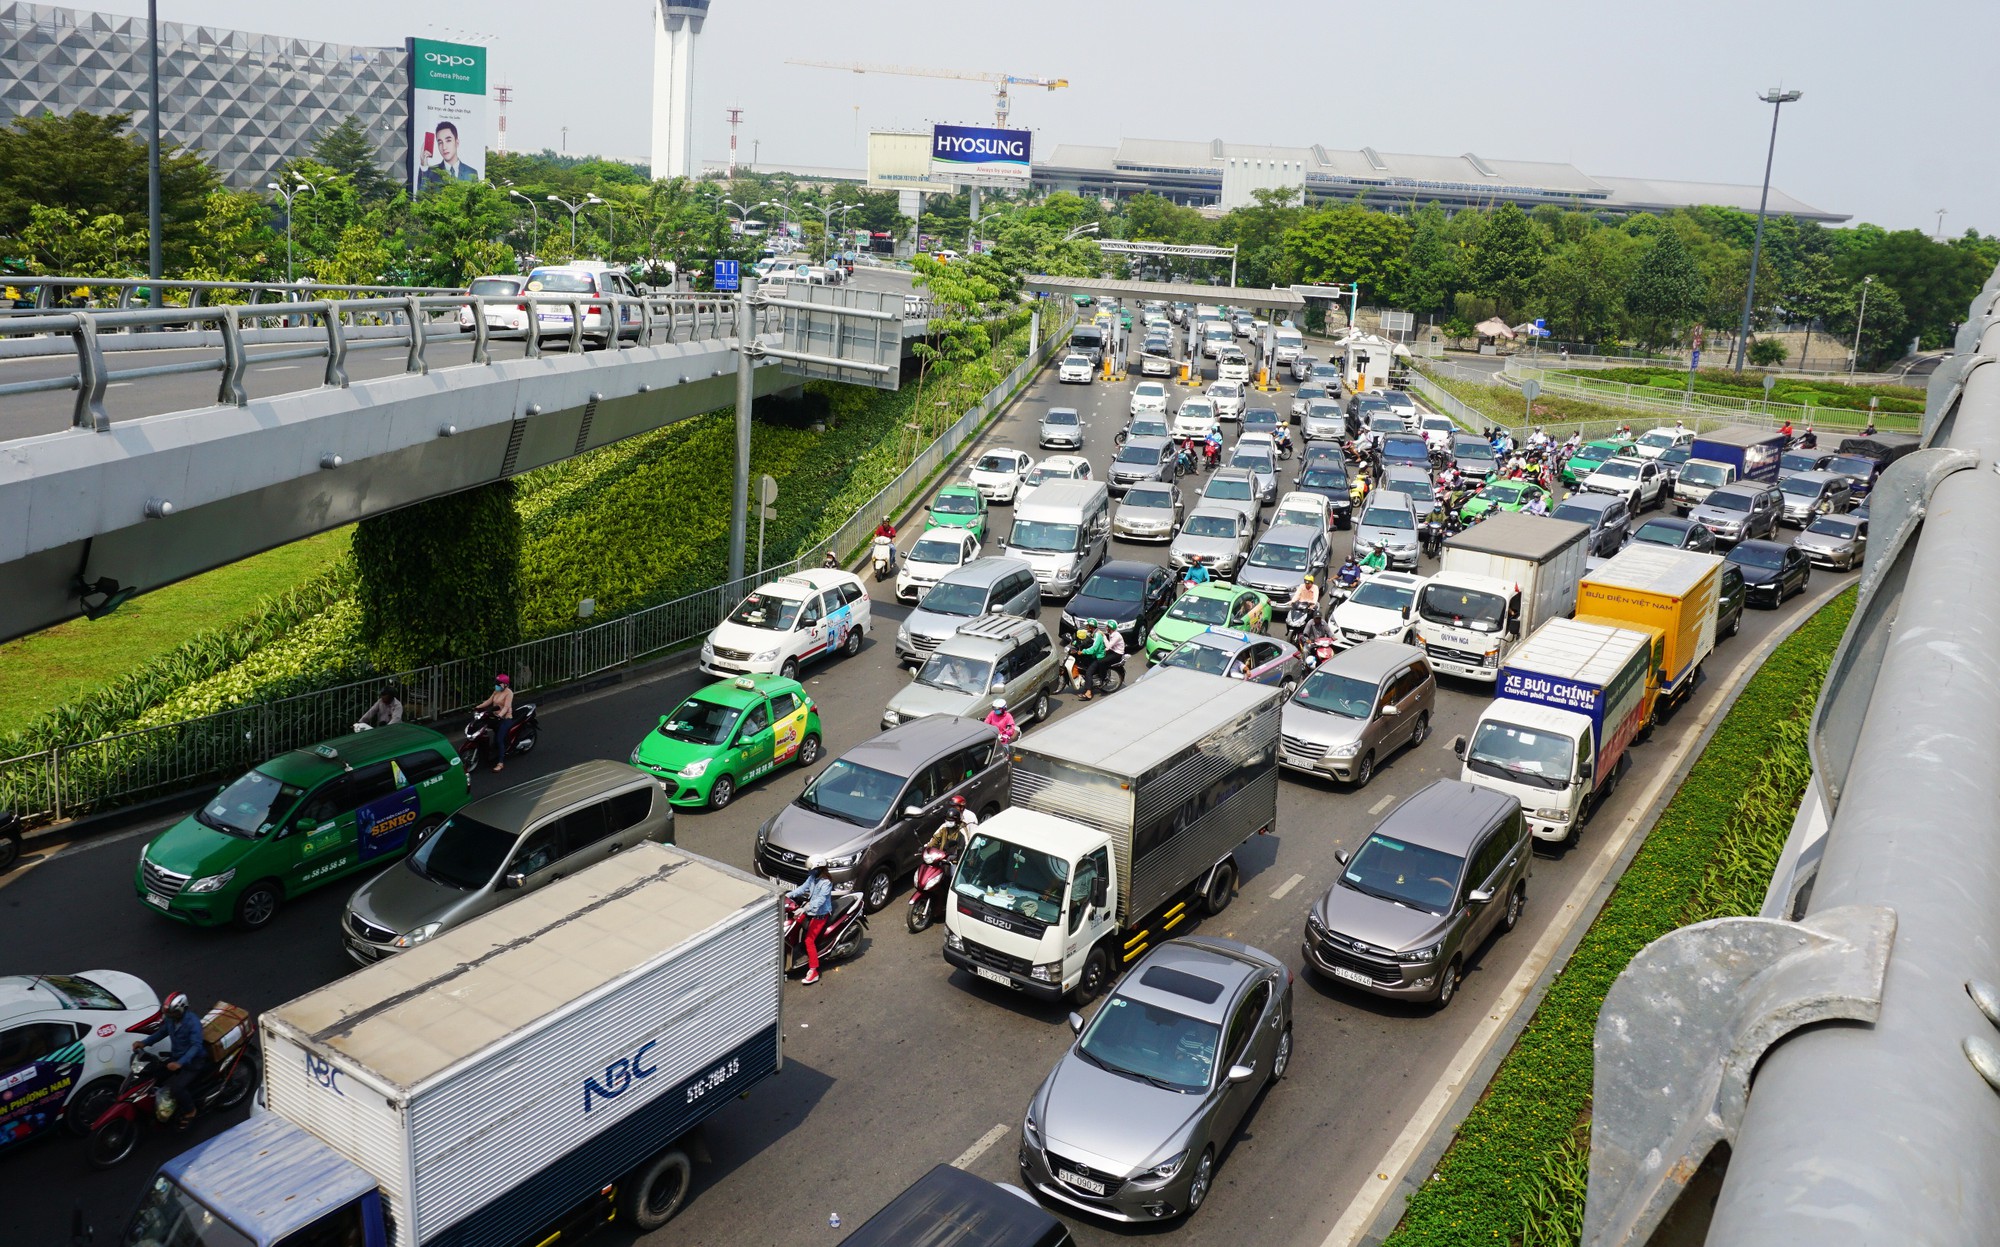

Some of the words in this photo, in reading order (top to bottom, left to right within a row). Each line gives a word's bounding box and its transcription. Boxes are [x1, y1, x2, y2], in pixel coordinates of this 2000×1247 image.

[429, 70, 451, 79] Camera
[452, 73, 470, 81] Phone
[443, 94, 456, 106] F5
[937, 136, 1024, 156] HYOSUNG
[1586, 591, 1604, 599] BƯU
[1607, 594, 1629, 603] ĐIỆN
[1631, 599, 1650, 607] VIỆT
[1505, 675, 1521, 687] XE
[1524, 678, 1550, 693] BƯU
[1553, 684, 1595, 703] CHÍNH
[1530, 691, 1545, 700] phát
[1546, 695, 1566, 704] nhanh
[371, 811, 416, 836] SENKO
[983, 914, 1012, 930] ISUZU
[50, 1077, 71, 1093] NAM
